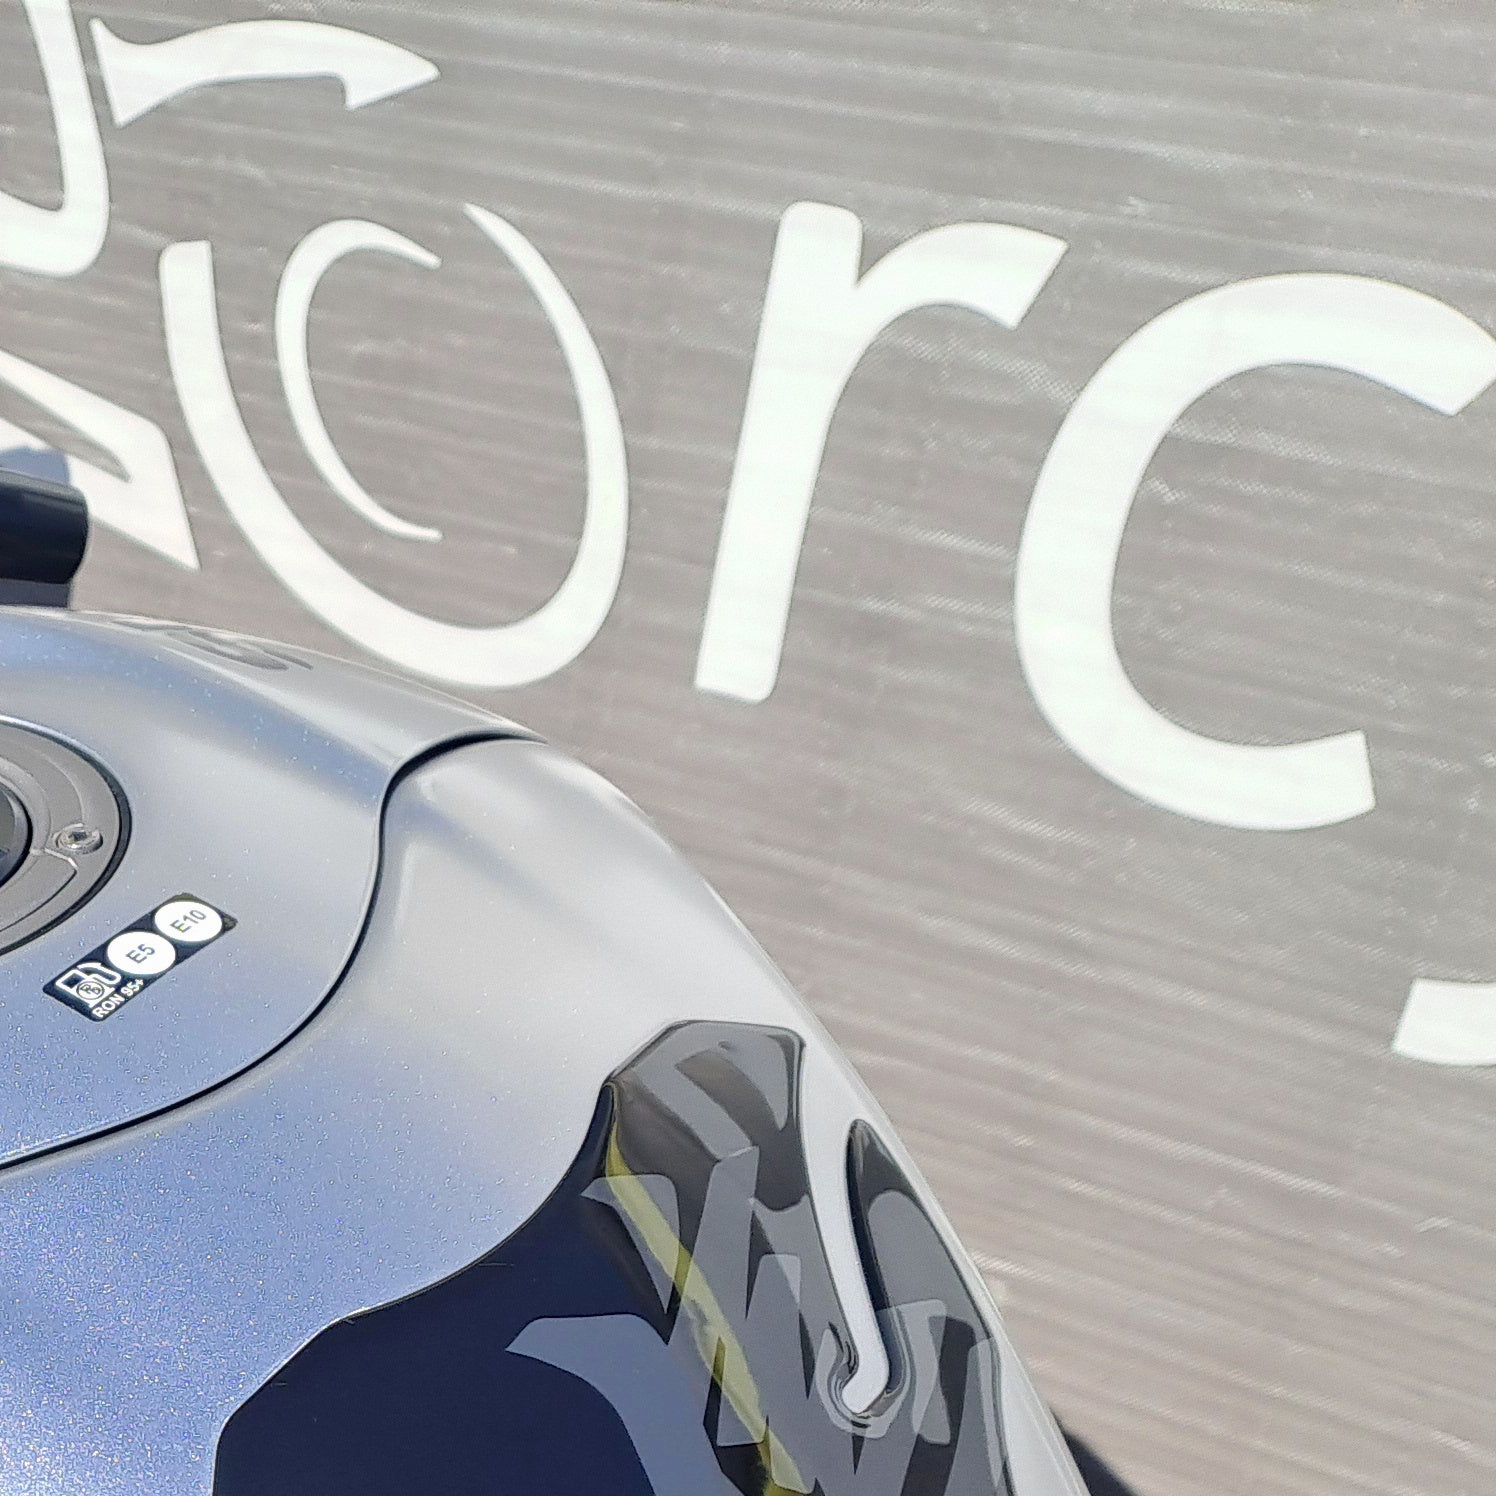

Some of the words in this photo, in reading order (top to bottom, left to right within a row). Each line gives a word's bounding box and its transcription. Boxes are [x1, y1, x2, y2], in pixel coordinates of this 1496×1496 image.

[170, 909, 207, 934] E10
[125, 943, 156, 964] E5
[92, 993, 126, 1018] RON
[120, 978, 144, 997] 95+
